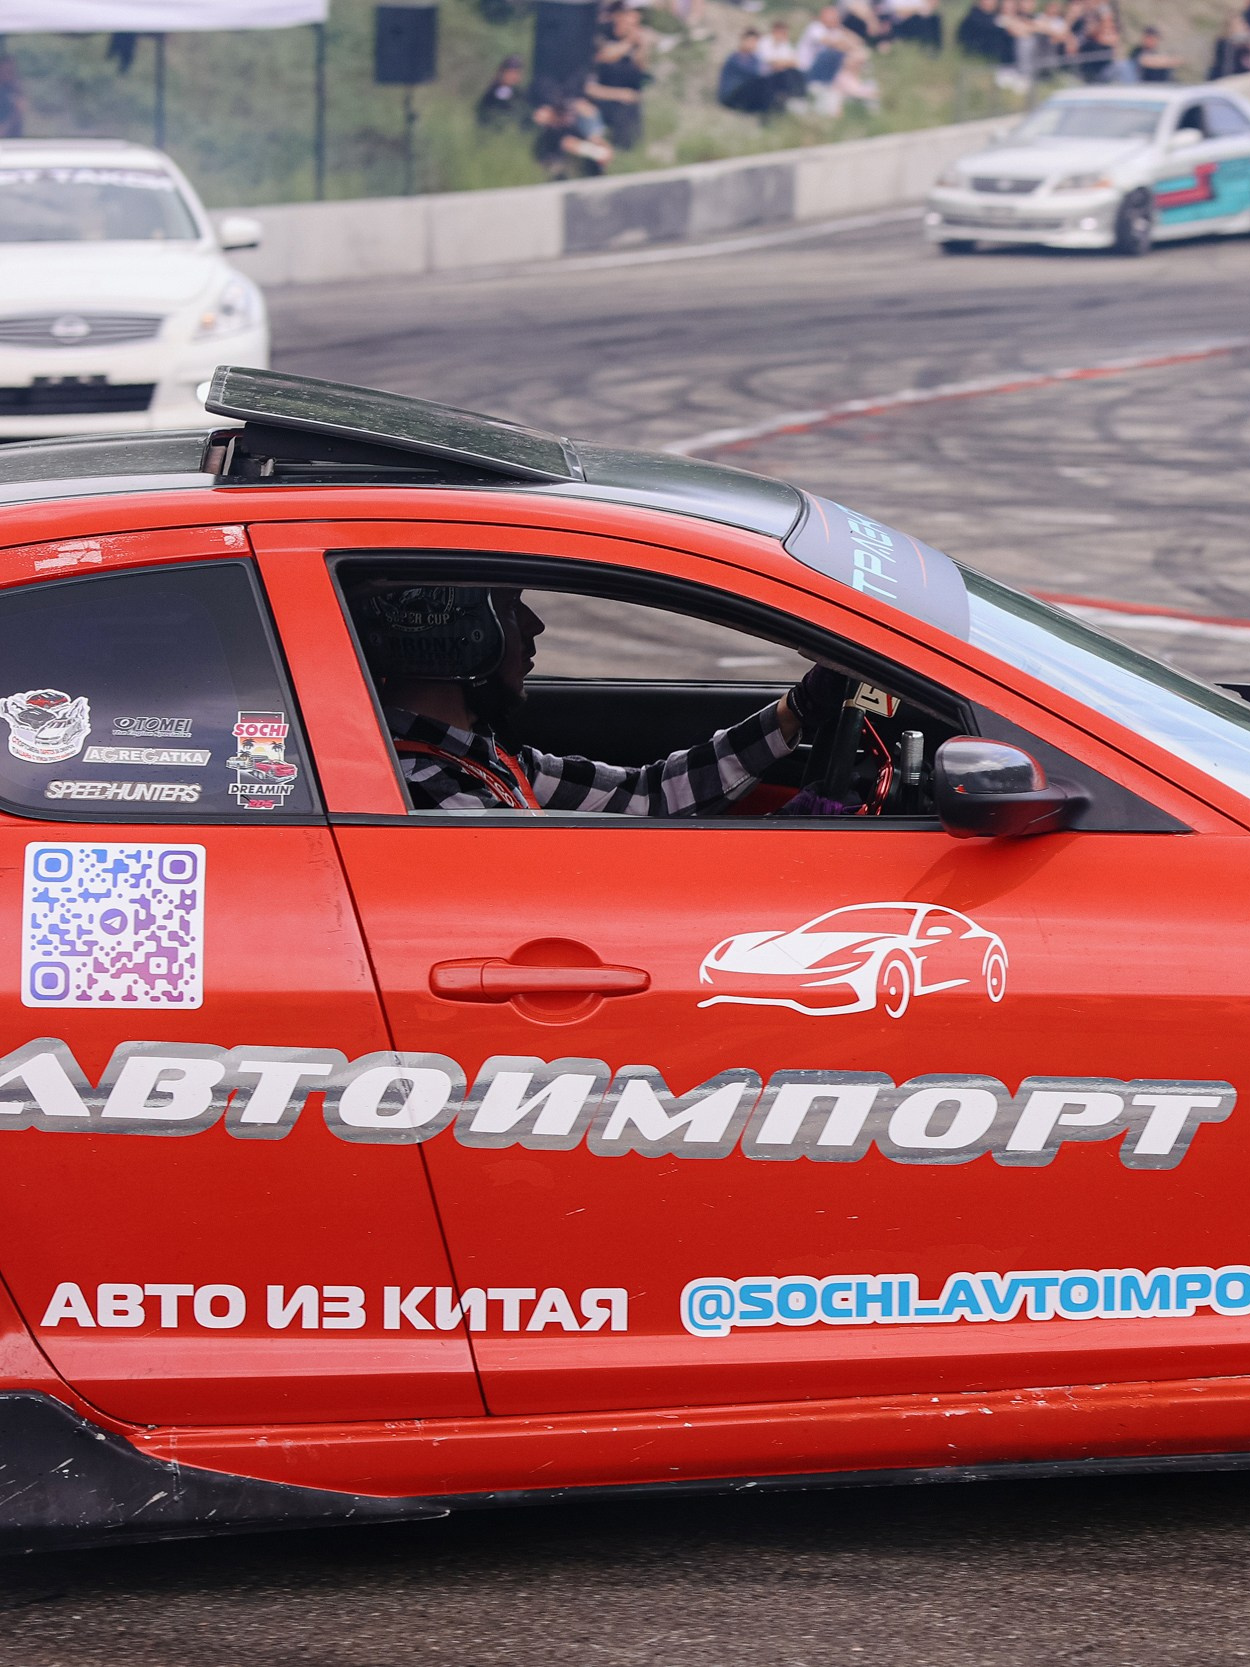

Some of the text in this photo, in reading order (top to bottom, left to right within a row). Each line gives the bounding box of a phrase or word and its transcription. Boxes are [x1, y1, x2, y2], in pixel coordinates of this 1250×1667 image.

[385, 612, 451, 624] SUPER CUP
[234, 724, 289, 737] SOCHI
[89, 748, 204, 764] AGREGATKA
[45, 781, 202, 804] SPEEDHUNTERS
[231, 785, 293, 795] DREAMIN'
[0, 1048, 1226, 1159] АВТОИМПОРТ
[41, 1282, 628, 1331] АВТО ИЗ КИТАЯ
